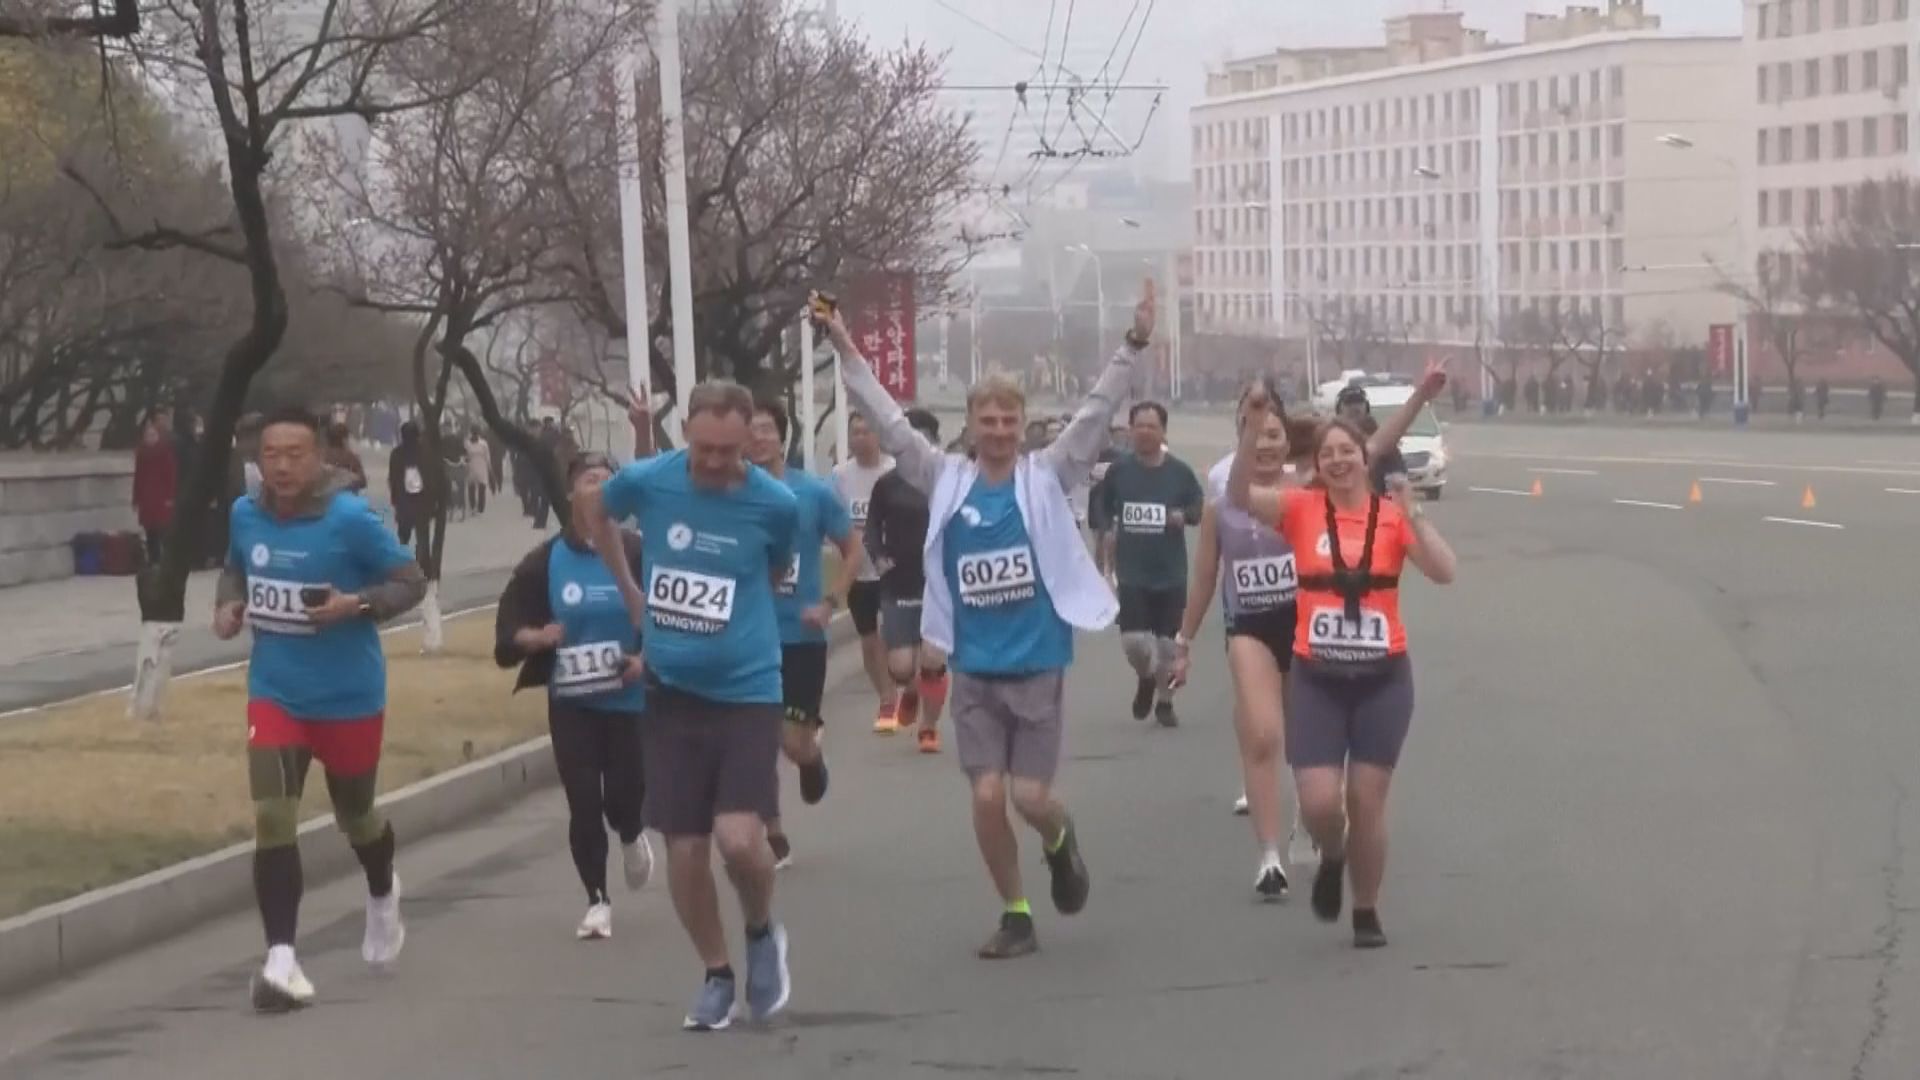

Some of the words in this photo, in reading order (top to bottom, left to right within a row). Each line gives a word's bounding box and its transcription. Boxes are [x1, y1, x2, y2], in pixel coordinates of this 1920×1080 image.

[1125, 505, 1162, 521] 6041
[962, 553, 1028, 586] 6025
[1237, 558, 1294, 588] 6104
[252, 582, 304, 613] 601
[653, 573, 729, 613] 6024
[650, 607, 726, 634] YONGYAN
[1313, 612, 1384, 641] 6111
[556, 647, 617, 678] 110
